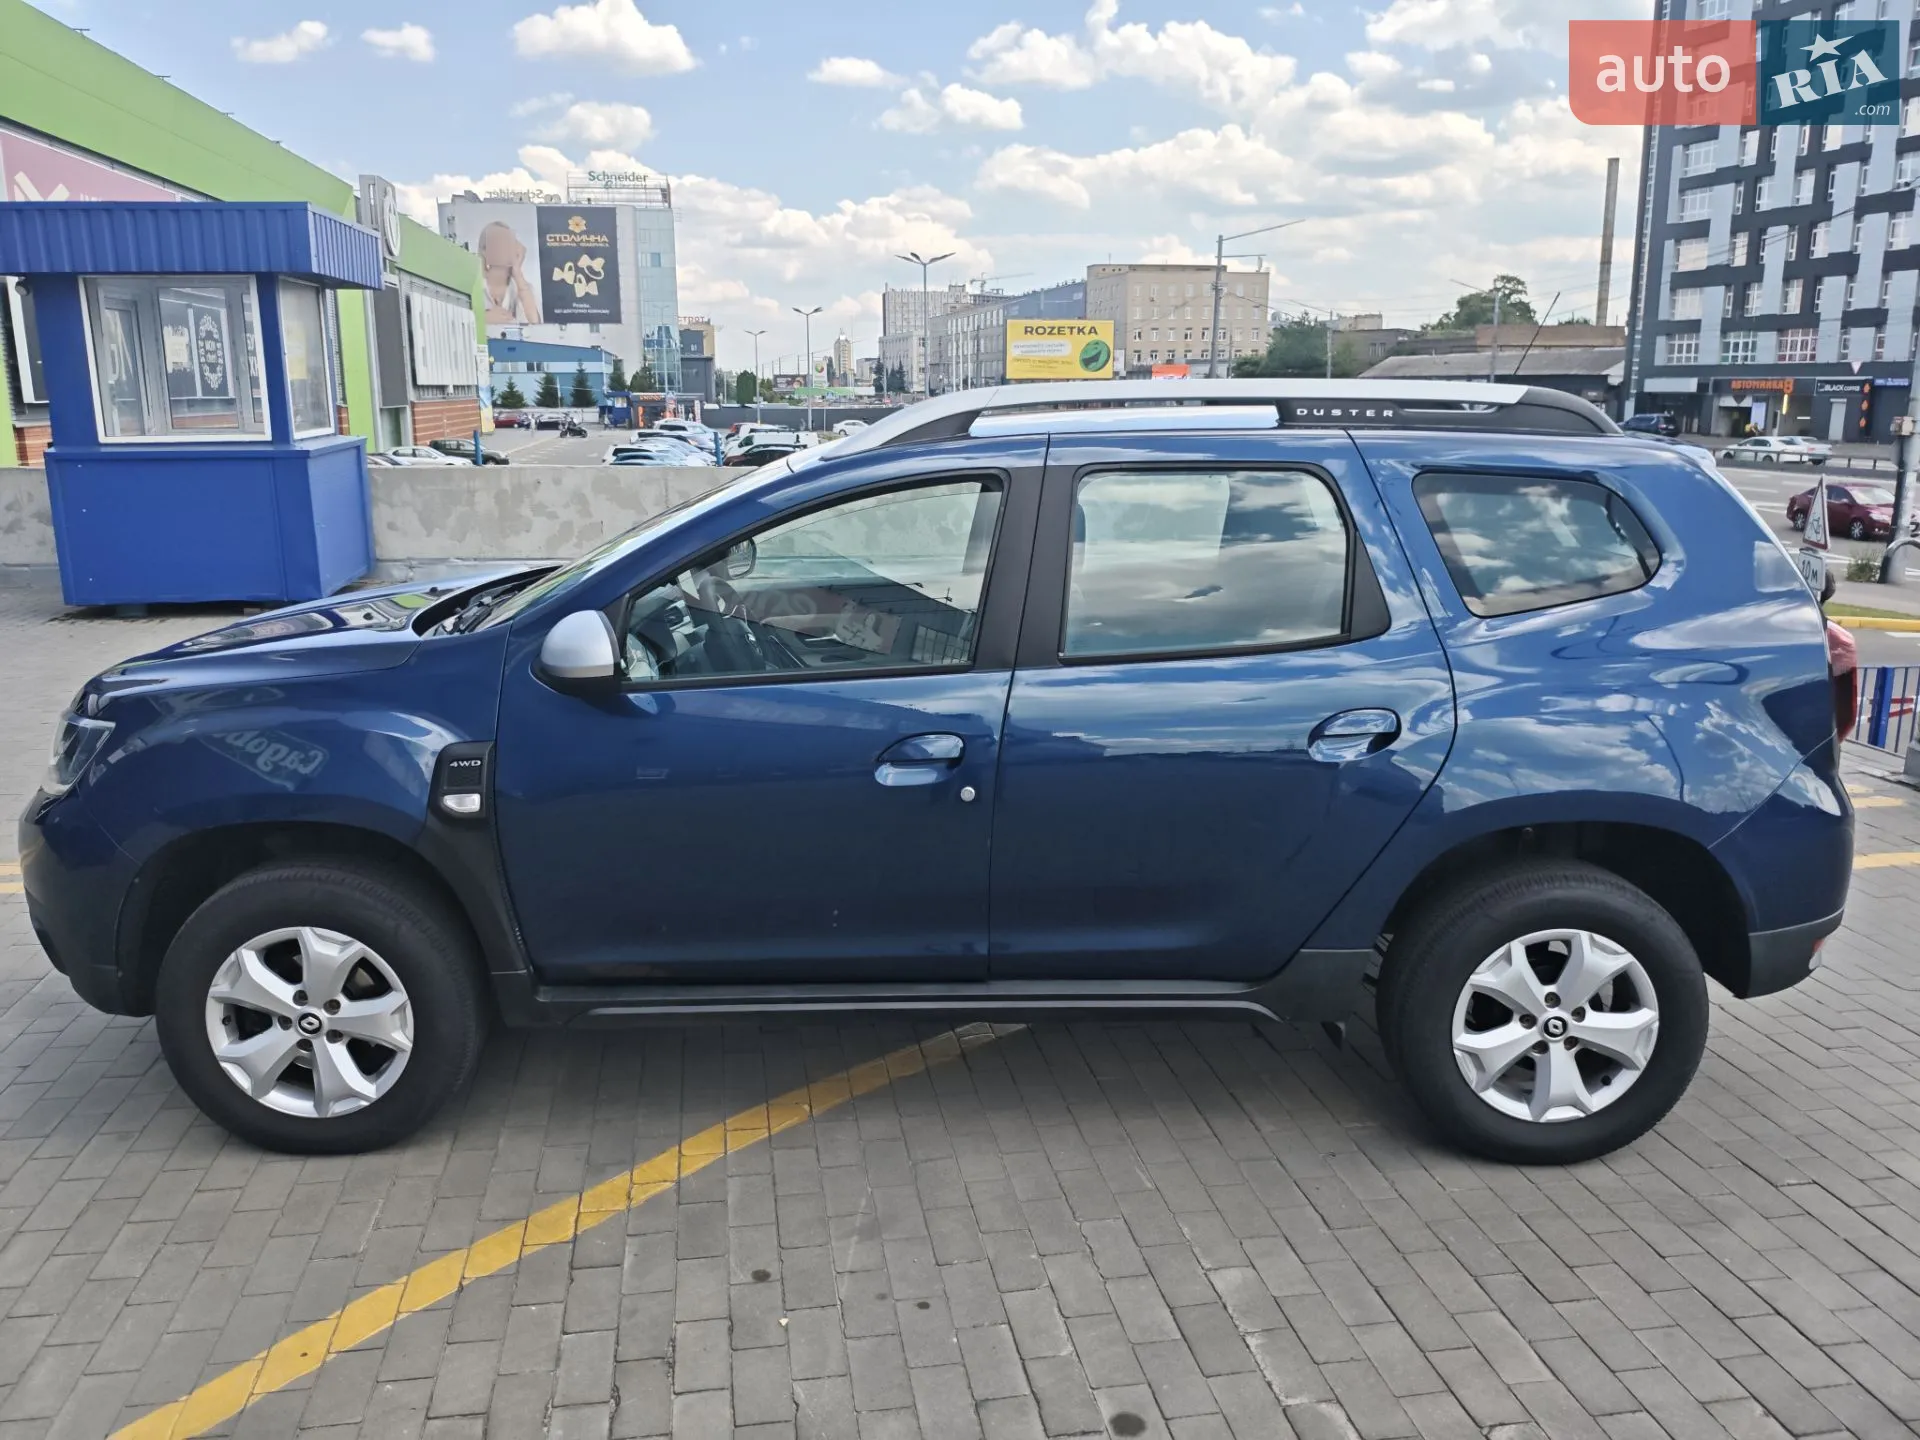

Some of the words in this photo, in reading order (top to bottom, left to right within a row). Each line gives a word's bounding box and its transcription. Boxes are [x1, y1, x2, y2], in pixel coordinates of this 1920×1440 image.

[588, 170, 648, 182] Schneider
[546, 233, 609, 242] СТОЛИЧНА
[1024, 325, 1098, 335] ROZETKA
[1296, 408, 1393, 417] DUSTER
[449, 759, 482, 767] 4WD
